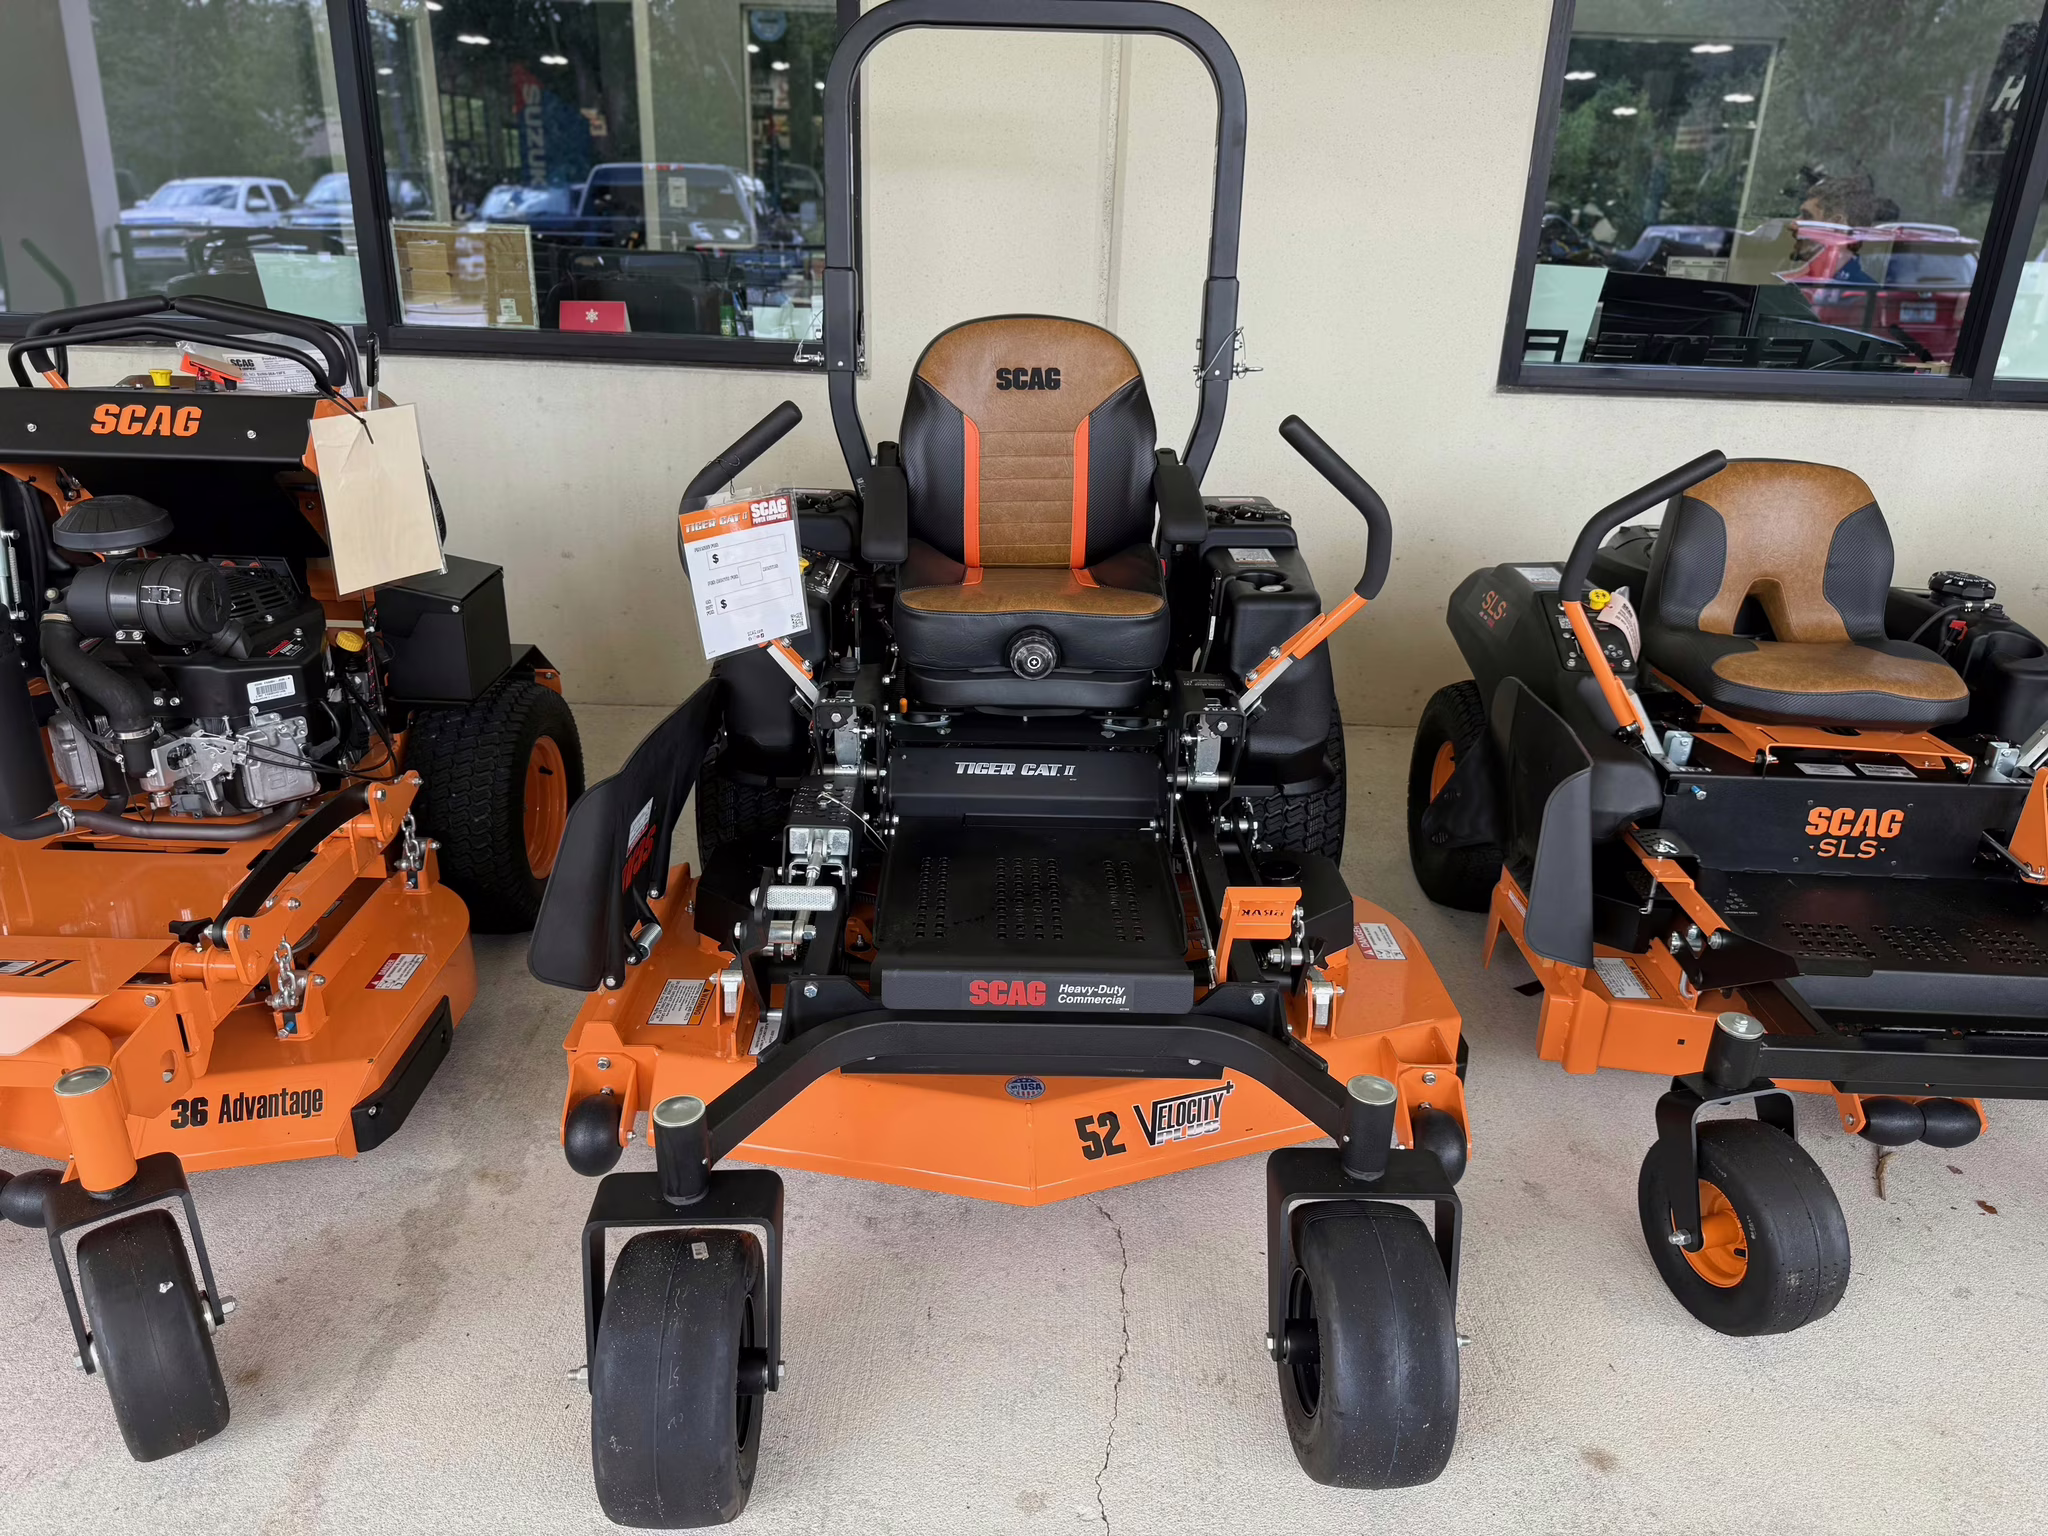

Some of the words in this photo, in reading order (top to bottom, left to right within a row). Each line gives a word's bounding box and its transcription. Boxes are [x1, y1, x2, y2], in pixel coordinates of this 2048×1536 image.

[522, 82, 549, 187] SUZUK
[996, 367, 1061, 390] SCAG
[90, 403, 203, 437] SCAG
[750, 498, 787, 518] SCAG
[684, 518, 716, 533] TIGER
[719, 513, 740, 525] CAT
[1482, 591, 1507, 620] SLS
[955, 761, 1016, 775] TIGER
[1063, 765, 1076, 776] II
[1805, 806, 1904, 838] SCAG
[1817, 839, 1878, 859] SLS
[969, 979, 1047, 1006] SCAG
[1058, 984, 1125, 996] Heavy-Duty
[1057, 994, 1127, 1005] Commercial
[1020, 1082, 1043, 1091] USA
[170, 1096, 209, 1130] 36
[218, 1087, 324, 1124] Advantage
[1074, 1110, 1127, 1161] 52
[1155, 1119, 1221, 1145] PLUS
